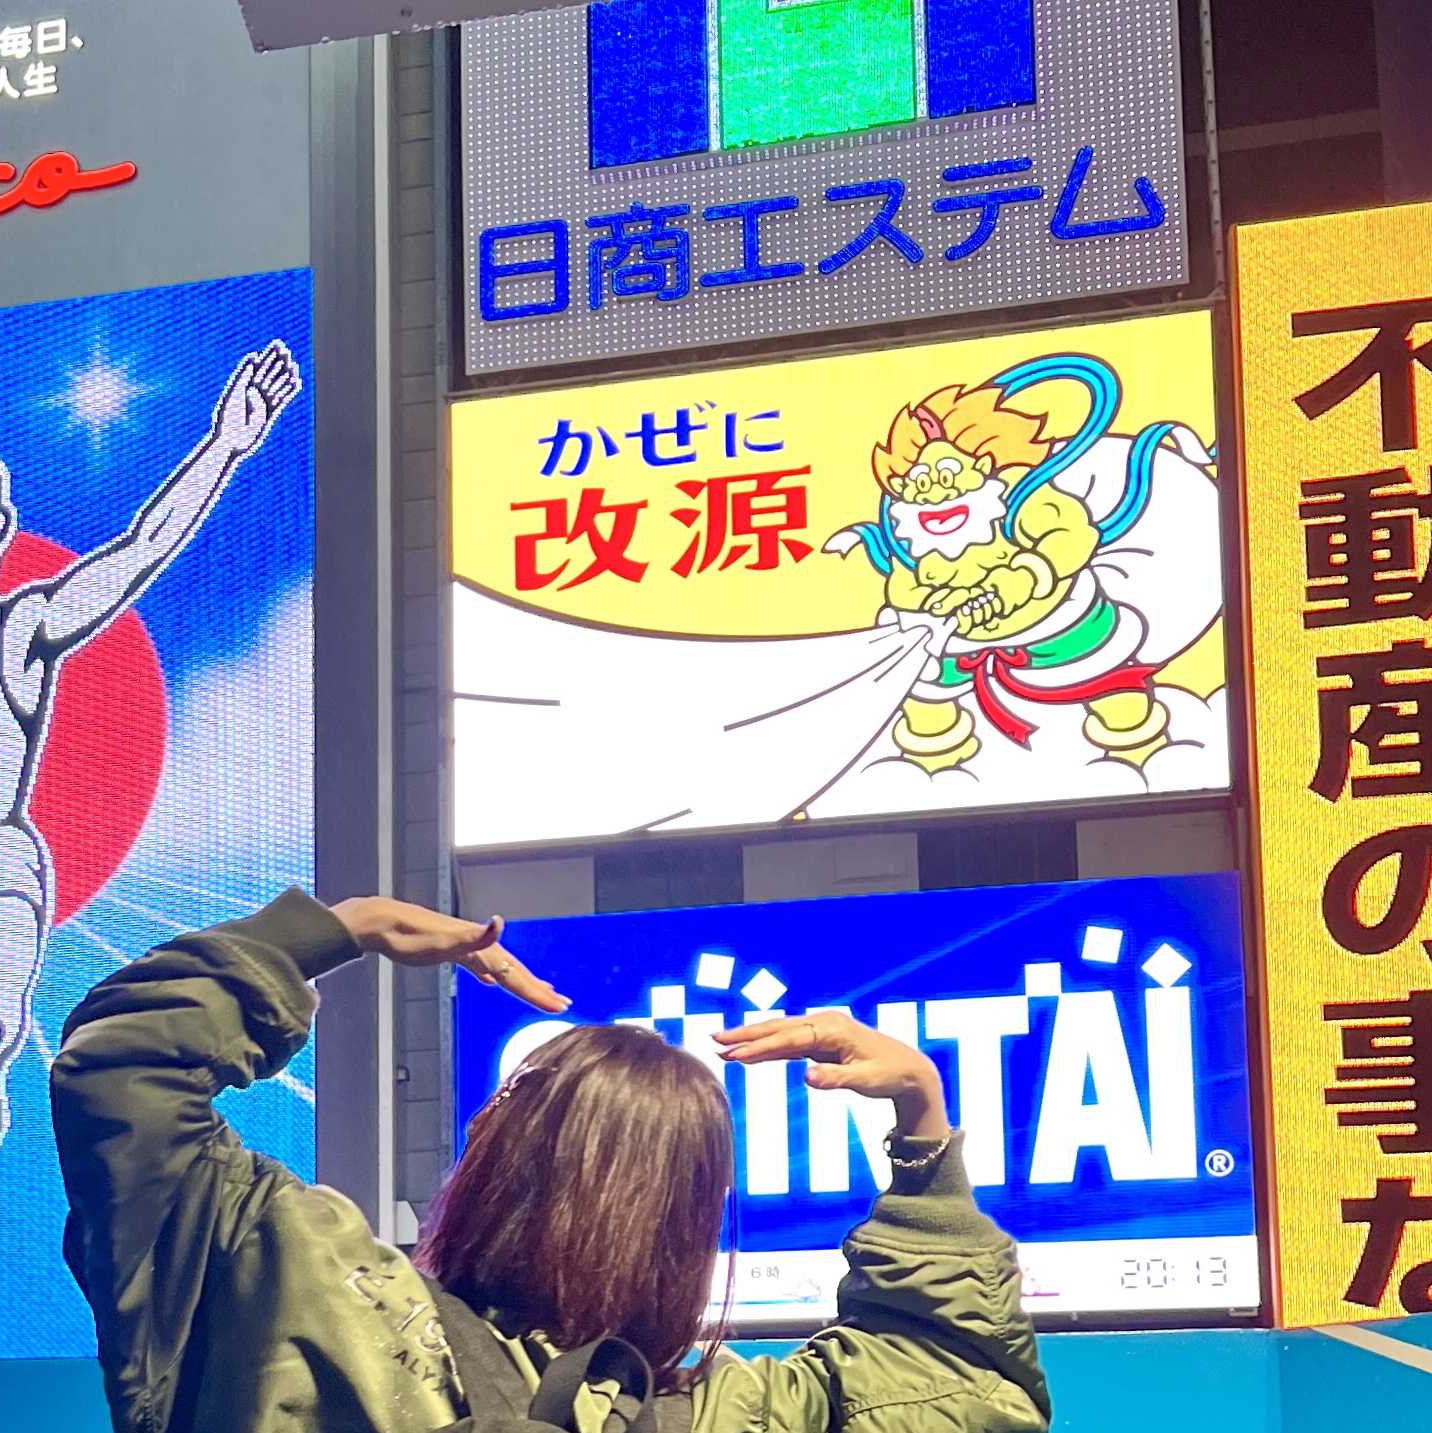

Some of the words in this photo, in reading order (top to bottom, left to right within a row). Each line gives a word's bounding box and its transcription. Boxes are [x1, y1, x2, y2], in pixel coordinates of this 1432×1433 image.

[479, 146, 1165, 322] 日商エステム
[538, 400, 784, 477] かぜに
[510, 464, 815, 592] 改源
[1121, 1257, 1227, 1289] 20:13
